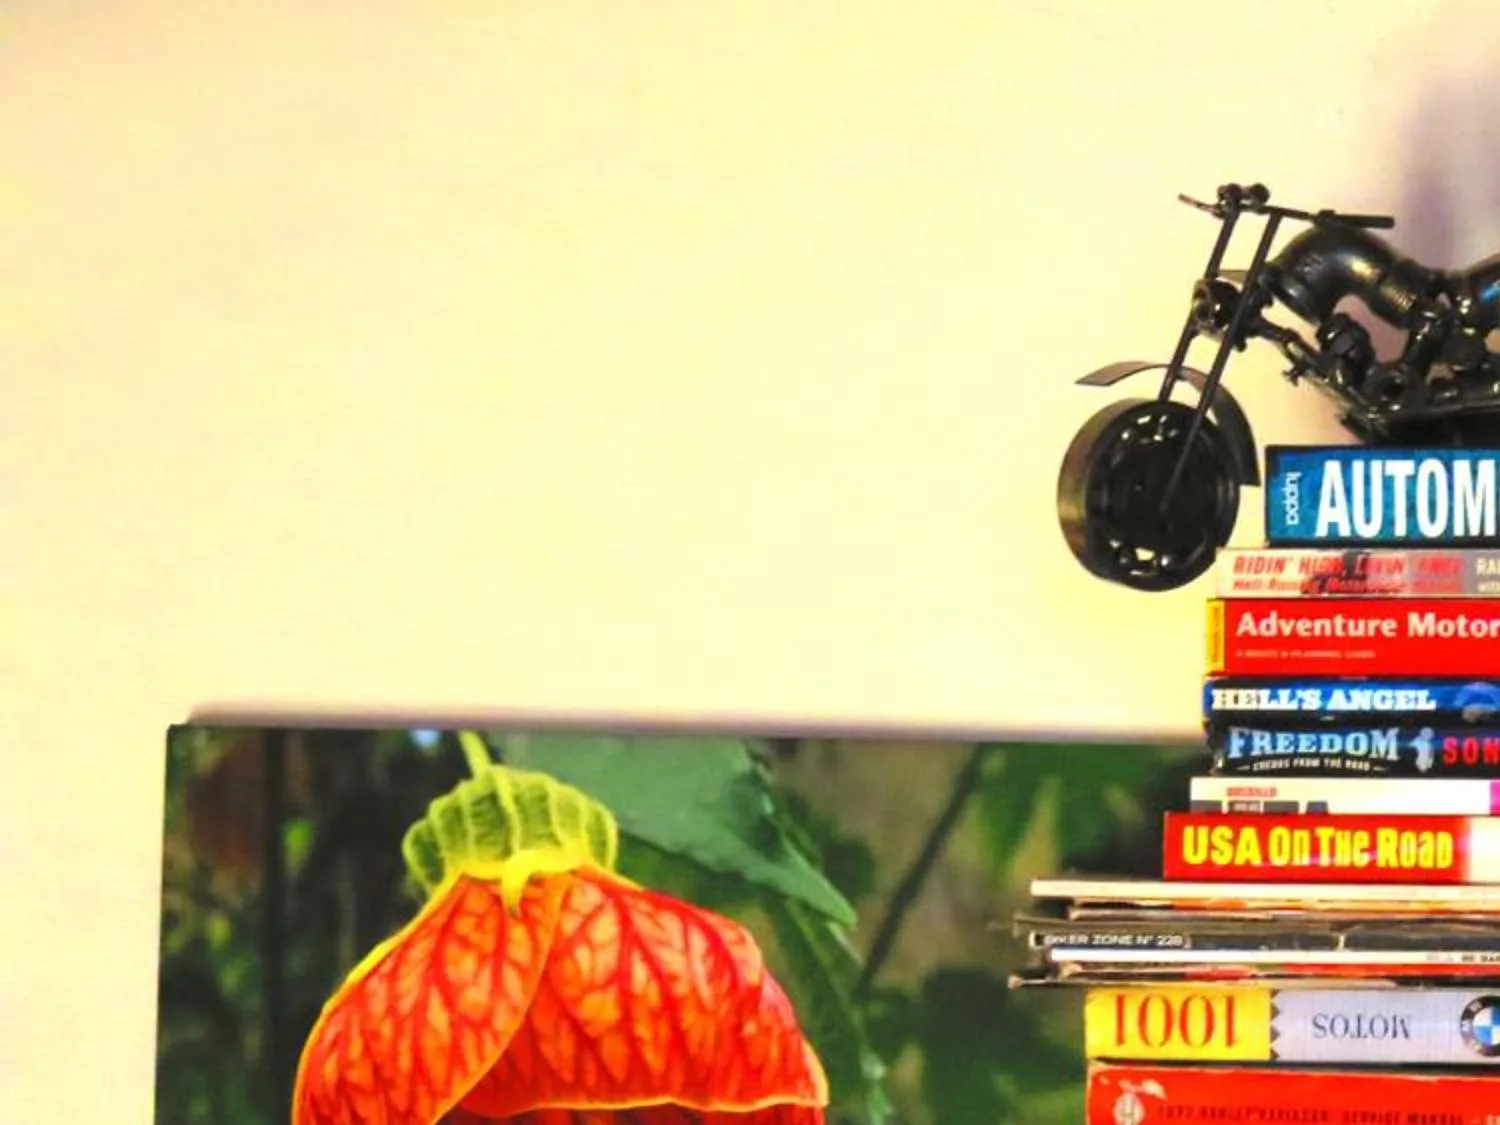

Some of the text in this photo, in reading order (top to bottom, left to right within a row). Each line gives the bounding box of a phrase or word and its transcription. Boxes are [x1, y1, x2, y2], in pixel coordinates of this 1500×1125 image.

[1236, 611, 1399, 639] Adventure
[1211, 688, 1438, 711] HELL'S ANGEL
[1226, 727, 1400, 761] FREEDOM
[1113, 993, 1242, 1049] 1001
[1311, 1012, 1411, 1041] MOTOS
